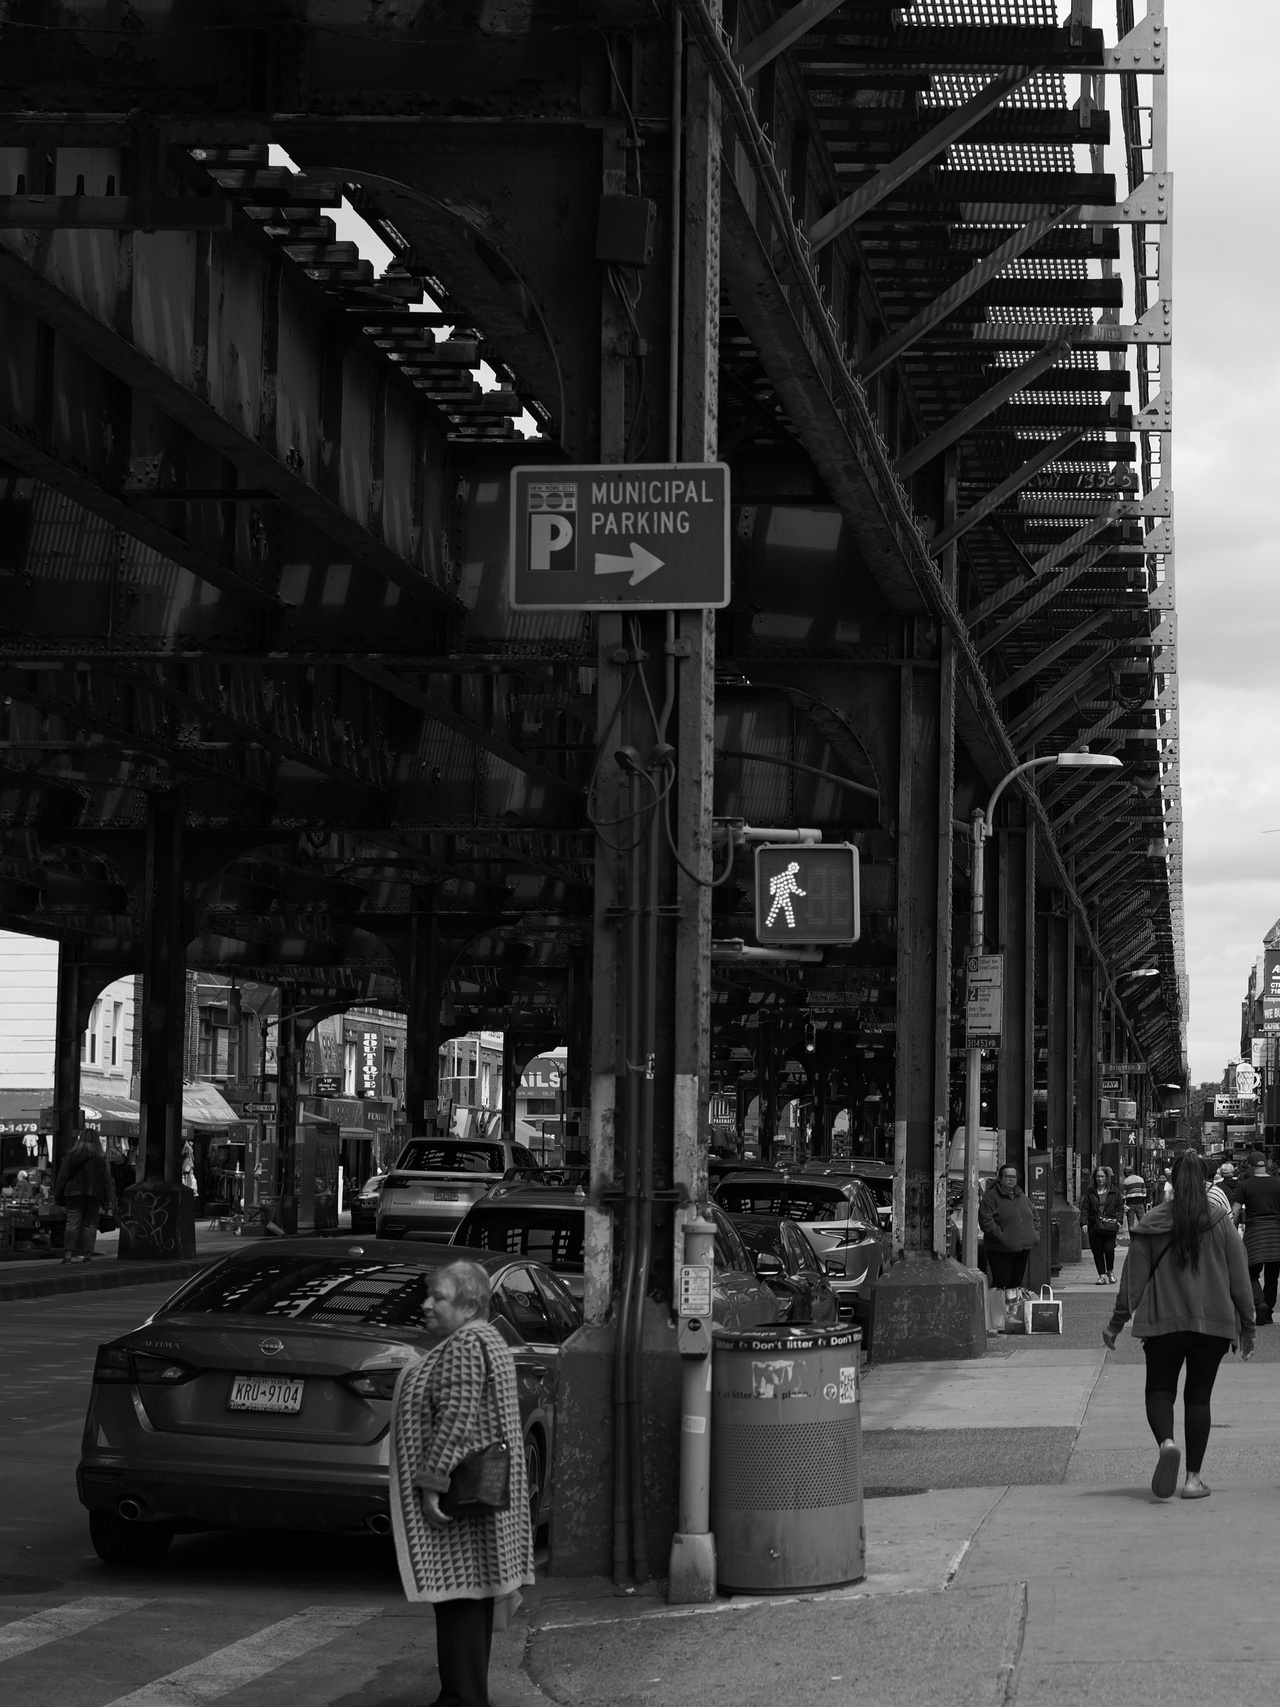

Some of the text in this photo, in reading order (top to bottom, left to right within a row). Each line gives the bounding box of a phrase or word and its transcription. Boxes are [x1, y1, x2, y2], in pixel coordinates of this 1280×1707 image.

[592, 480, 714, 504] MUNICIPAL
[591, 510, 691, 535] PARKING
[531, 513, 573, 571] P
[970, 988, 976, 1000] 2
[363, 1032, 380, 1088] BOUTIQUE
[521, 1071, 561, 1088] AILS
[1035, 1166, 1044, 1180] P
[141, 1340, 180, 1350] ALTIMA
[752, 1340, 783, 1351] Don't
[786, 1339, 814, 1350] litter
[830, 1335, 853, 1347] Don't
[253, 1376, 289, 1386] NEW YORK
[732, 1390, 753, 1400] litter
